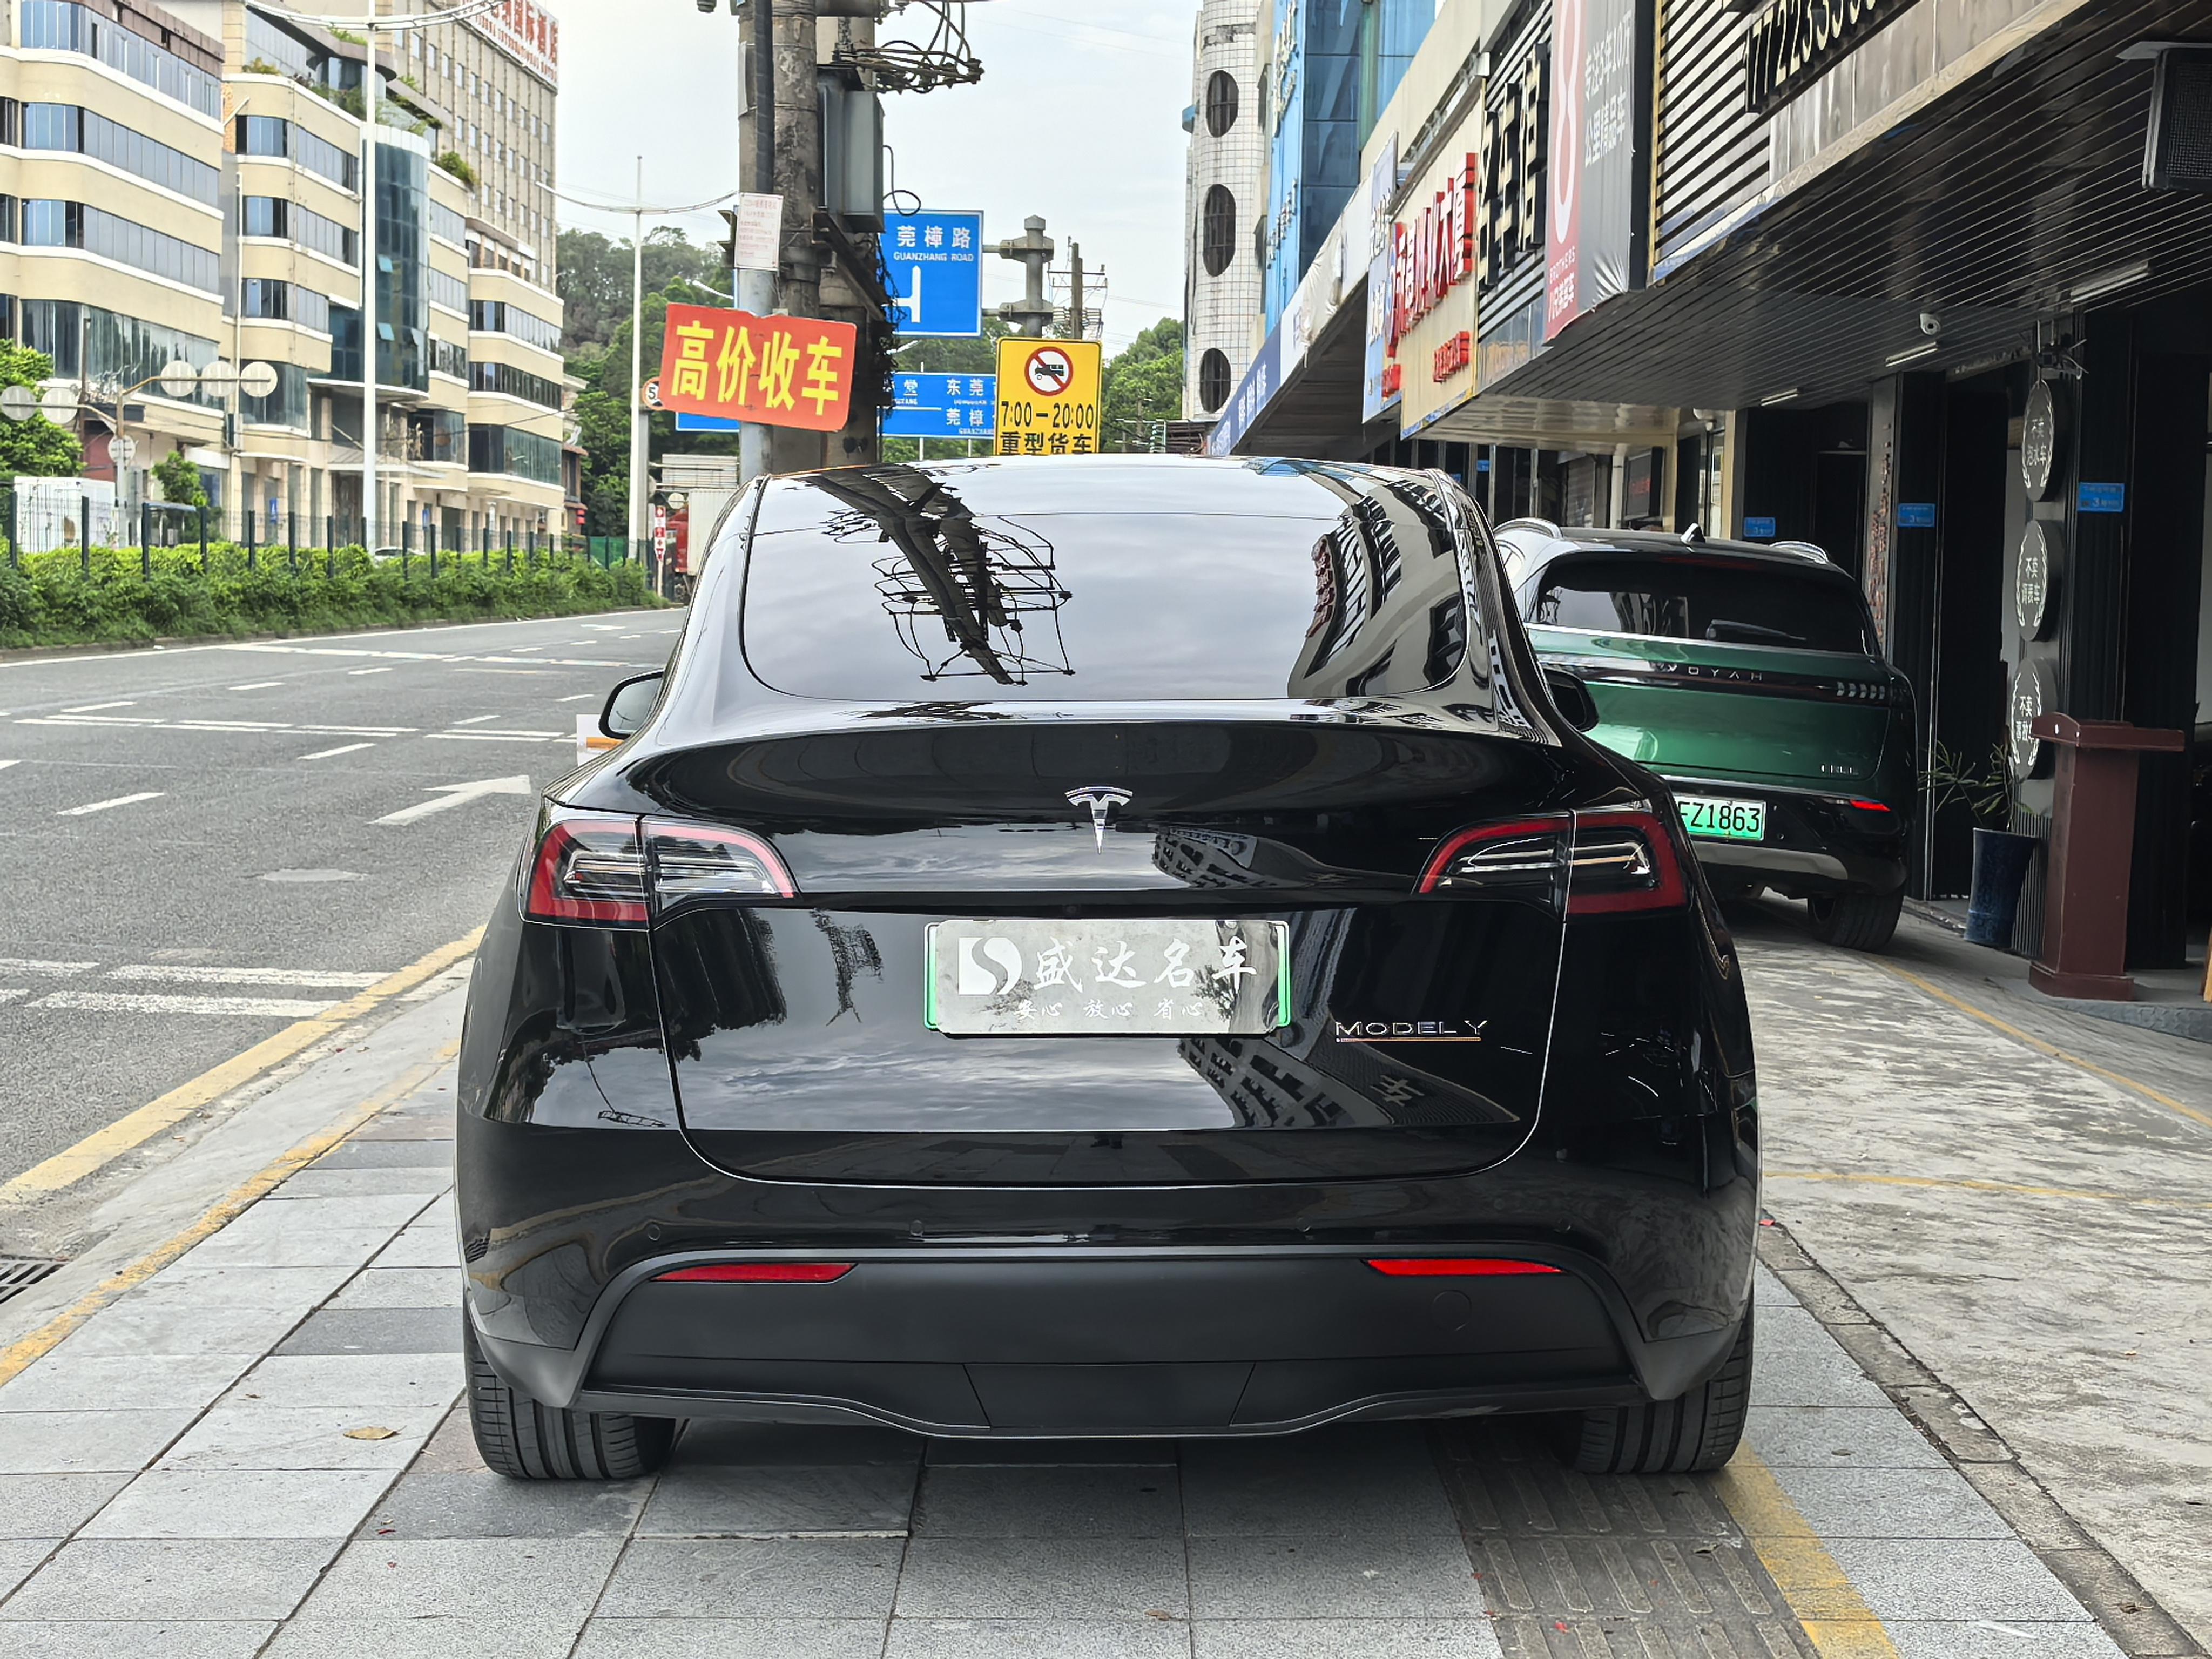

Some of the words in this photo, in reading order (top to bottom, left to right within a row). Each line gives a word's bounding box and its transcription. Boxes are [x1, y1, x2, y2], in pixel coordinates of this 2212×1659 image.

[896, 225, 971, 249] 莞樟路
[893, 251, 947, 261] GUANZHANG
[951, 253, 974, 262] ROAD
[671, 320, 842, 416] 高价收车
[946, 378, 995, 396] 东莞
[946, 408, 995, 427] 莞樟
[1000, 431, 1092, 455] 重型货车
[1668, 663, 1762, 681] VOYAH
[1033, 936, 1257, 995] 盛达名车
[1014, 999, 1063, 1021] 安心
[1082, 999, 1133, 1019] 放心
[1153, 999, 1204, 1020] 省心
[1335, 1021, 1457, 1036] MODEL
[1464, 1020, 1488, 1035] Y
